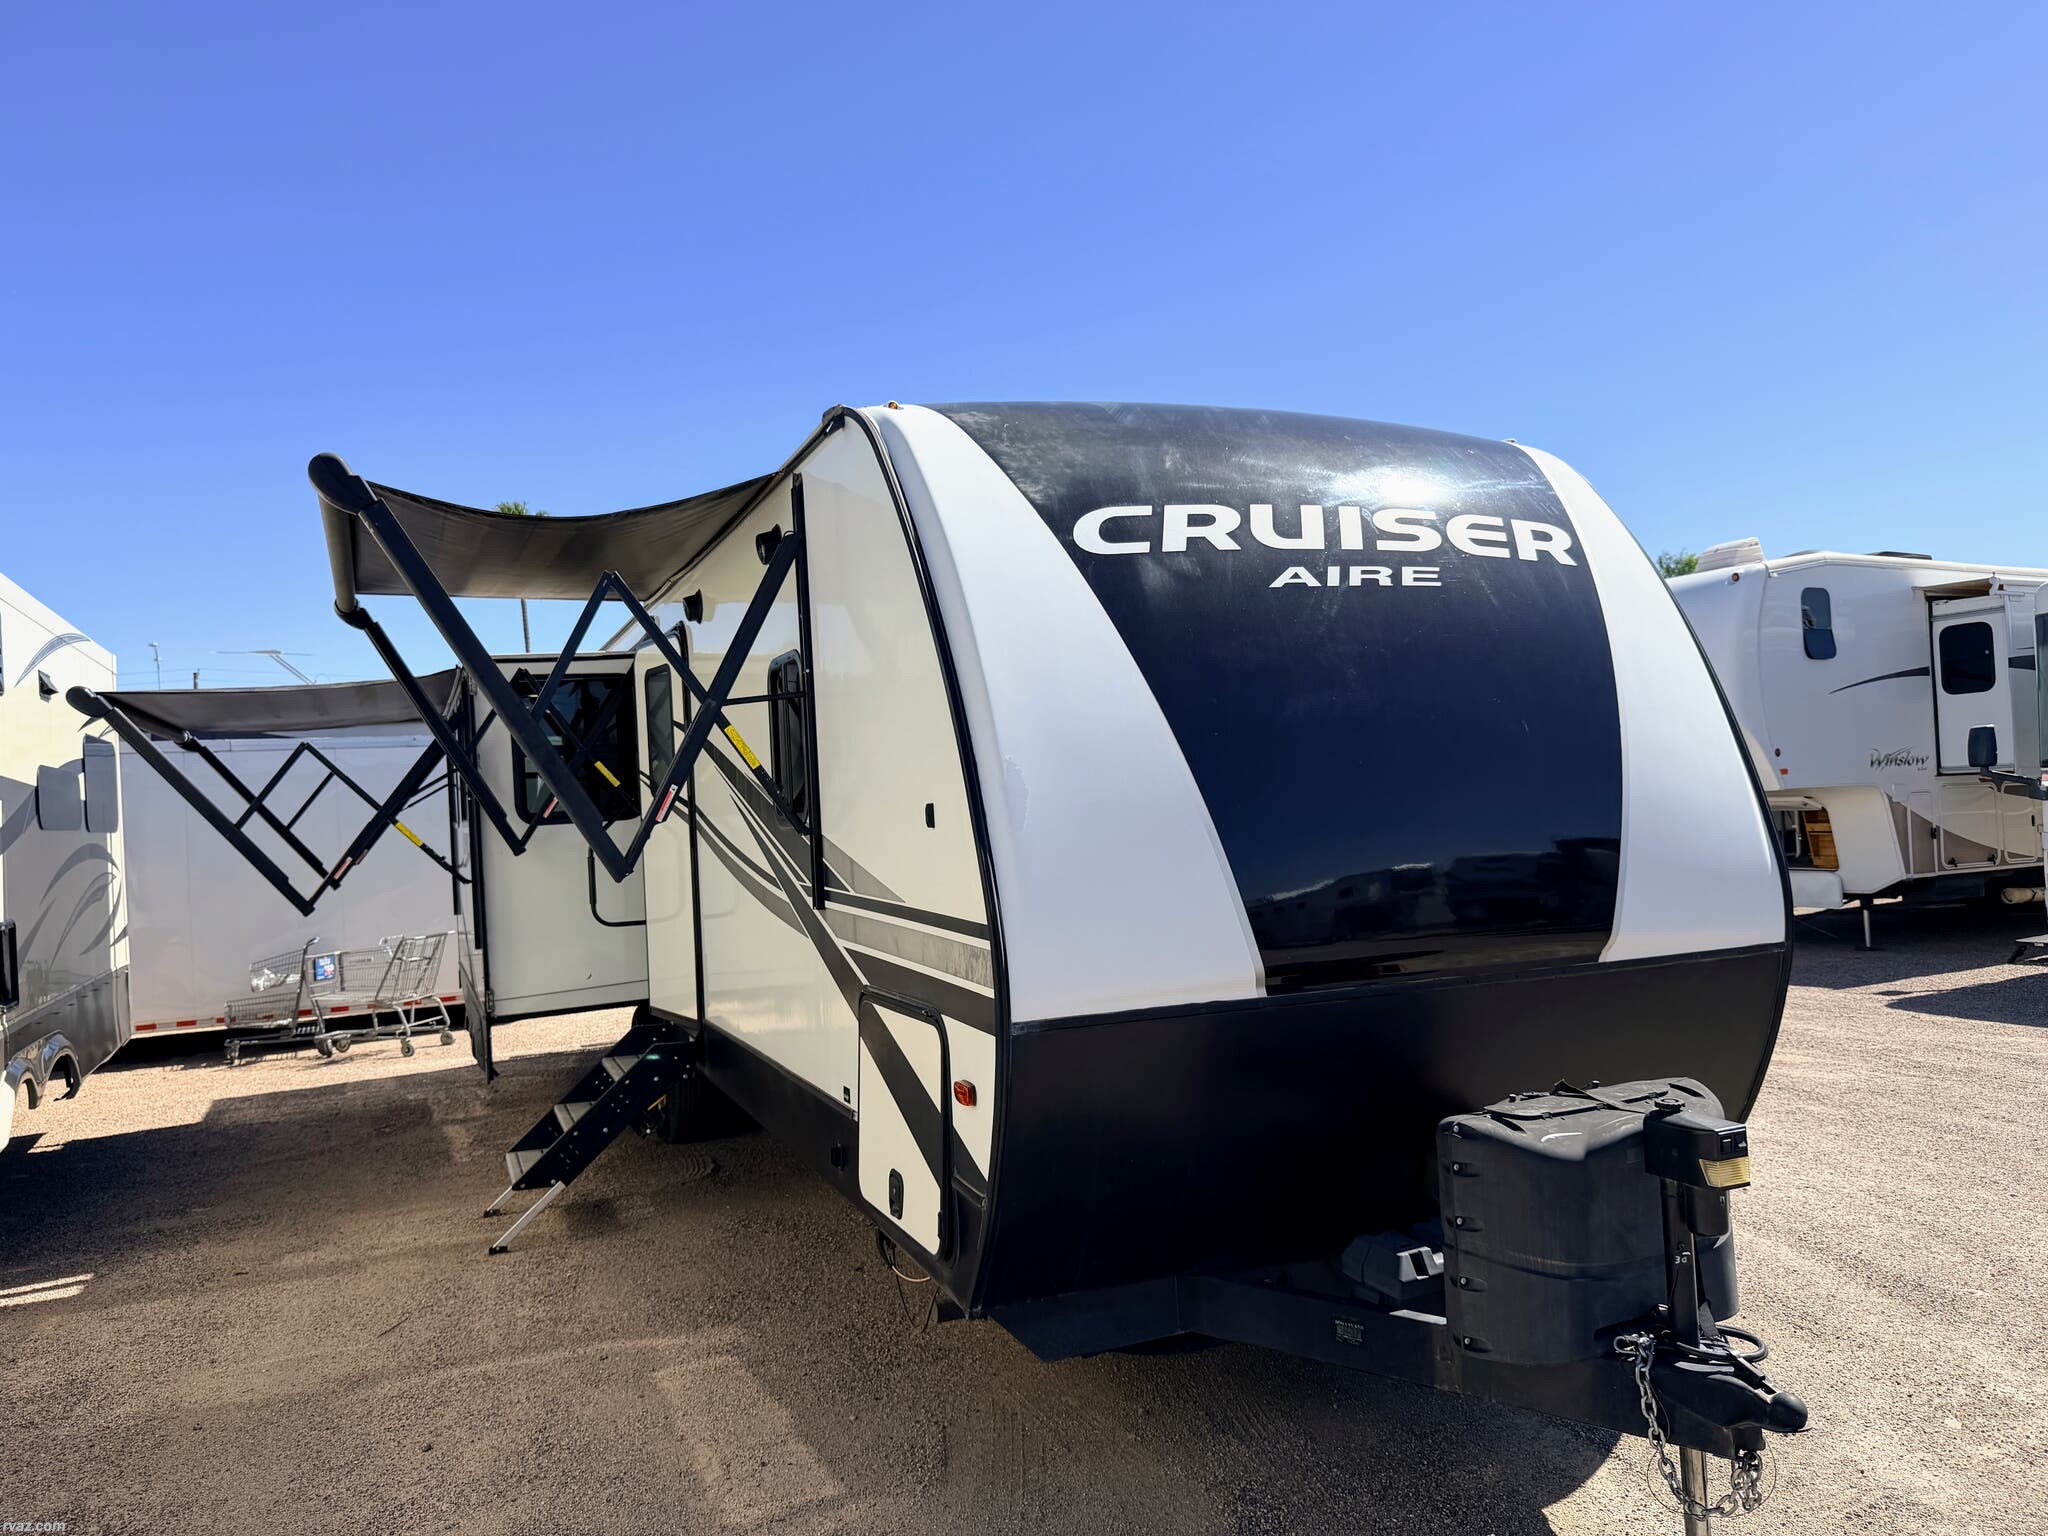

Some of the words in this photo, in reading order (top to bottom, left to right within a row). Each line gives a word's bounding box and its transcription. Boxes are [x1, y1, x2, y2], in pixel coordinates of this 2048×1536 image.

[1072, 503, 1578, 566] CRUISER
[1268, 565, 1443, 588] AIRE
[1870, 748, 1931, 770] Winslow
